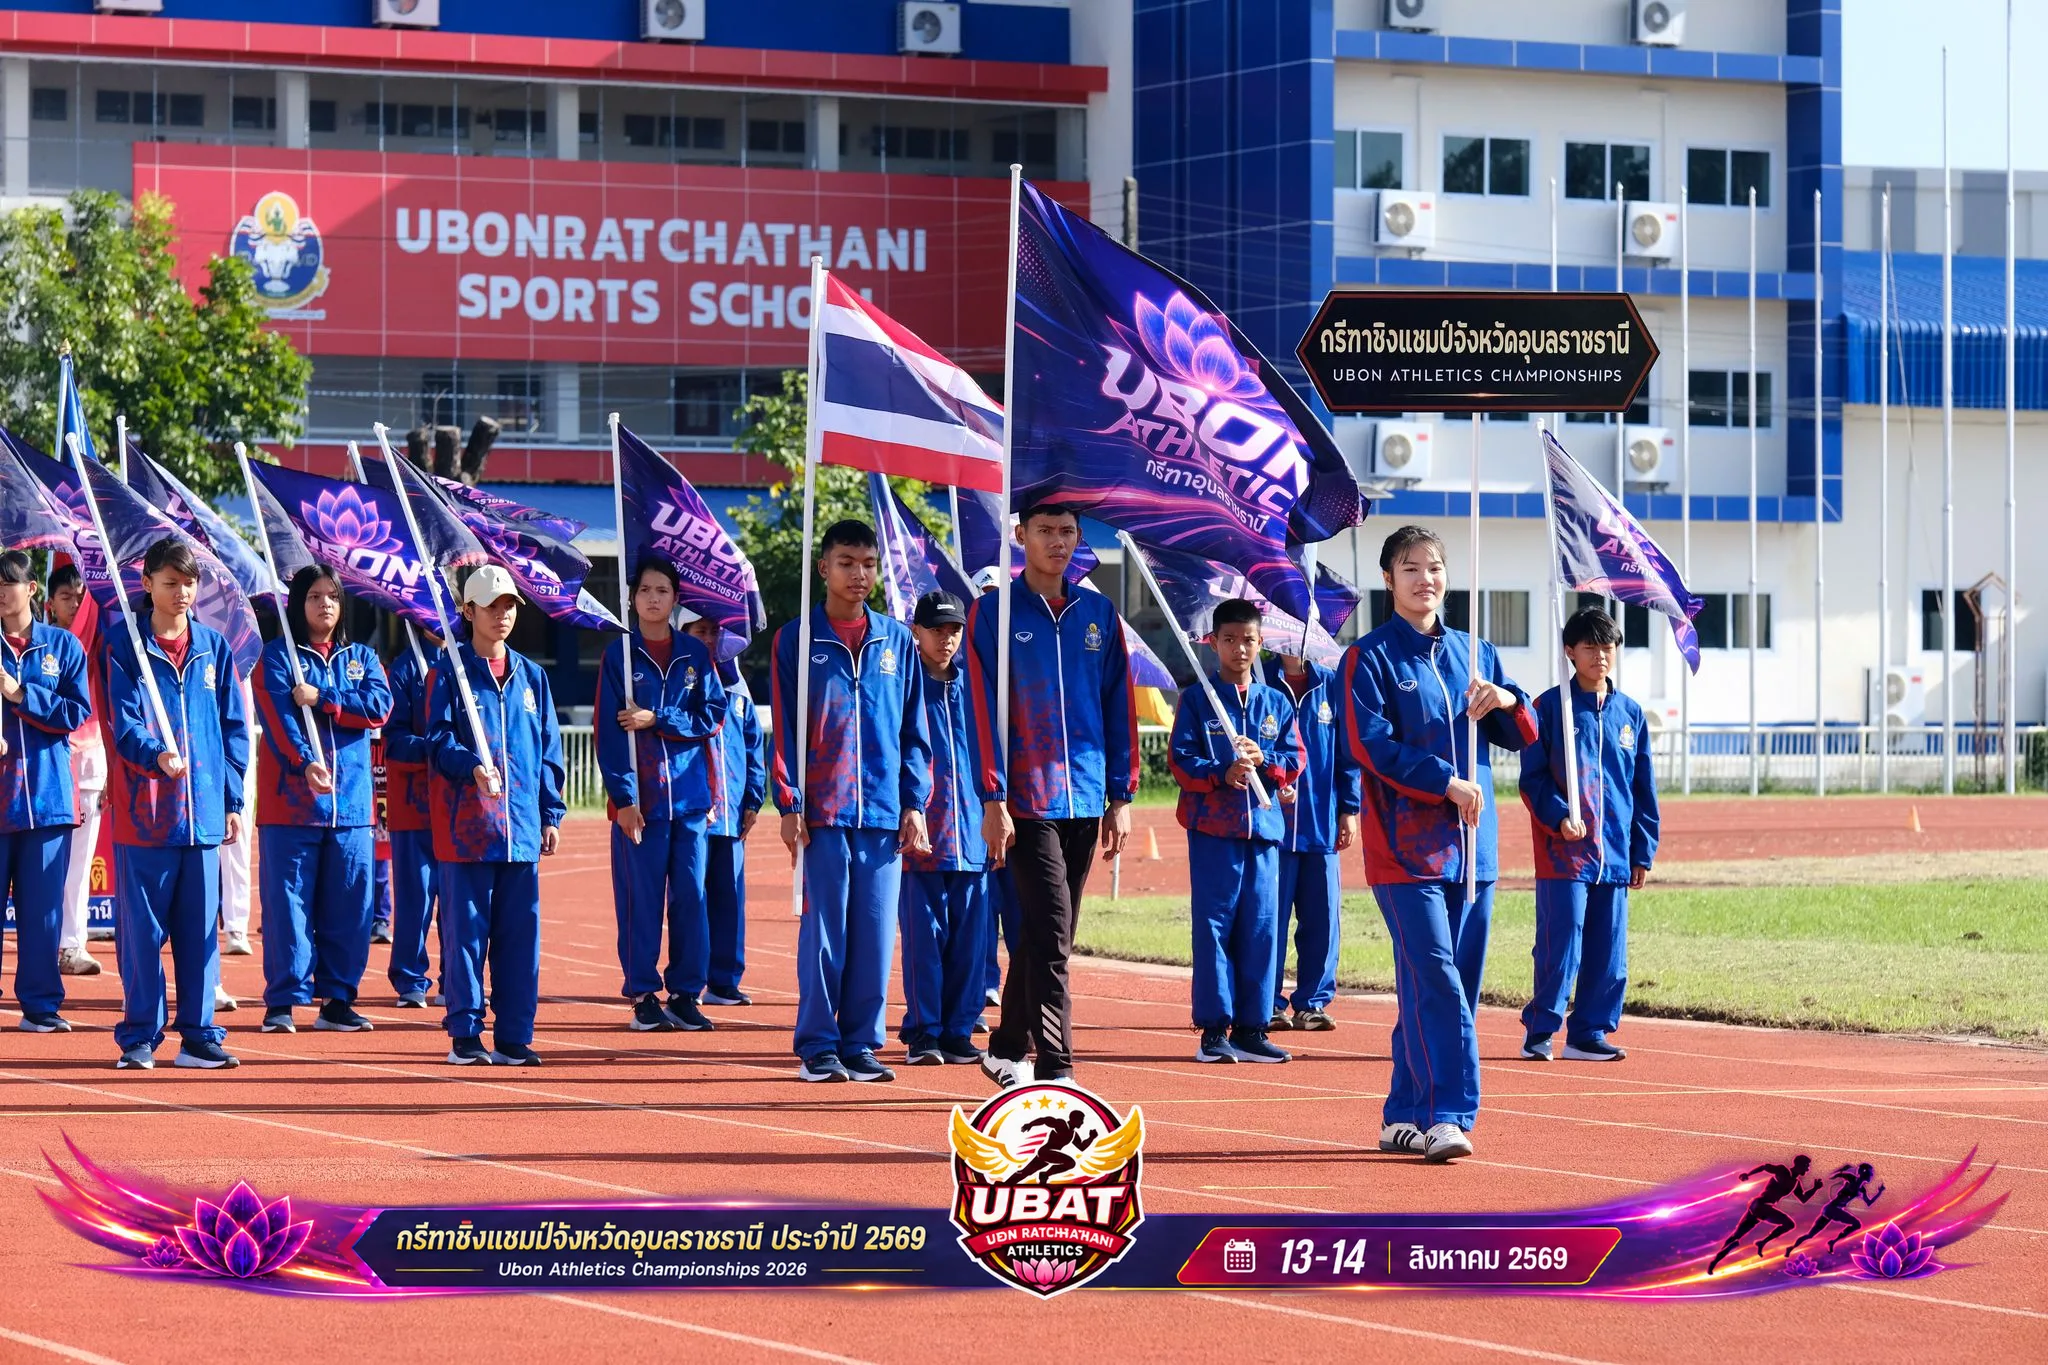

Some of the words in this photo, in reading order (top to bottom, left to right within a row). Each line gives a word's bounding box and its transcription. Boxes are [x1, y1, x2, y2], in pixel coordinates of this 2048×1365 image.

[396, 207, 927, 273] UBONRATCHATHANI
[458, 273, 660, 324] SPORTS
[689, 281, 873, 329] SCHO
[1320, 319, 1630, 364] กรีฑาชิงแชมป์จังหวัดอุบลราชธานี
[1333, 368, 1382, 382] UBON
[1390, 368, 1483, 382] ATHLETICS
[1490, 368, 1622, 382] CHAMPIONSHIPS
[1094, 410, 1296, 518] ATHLETIC
